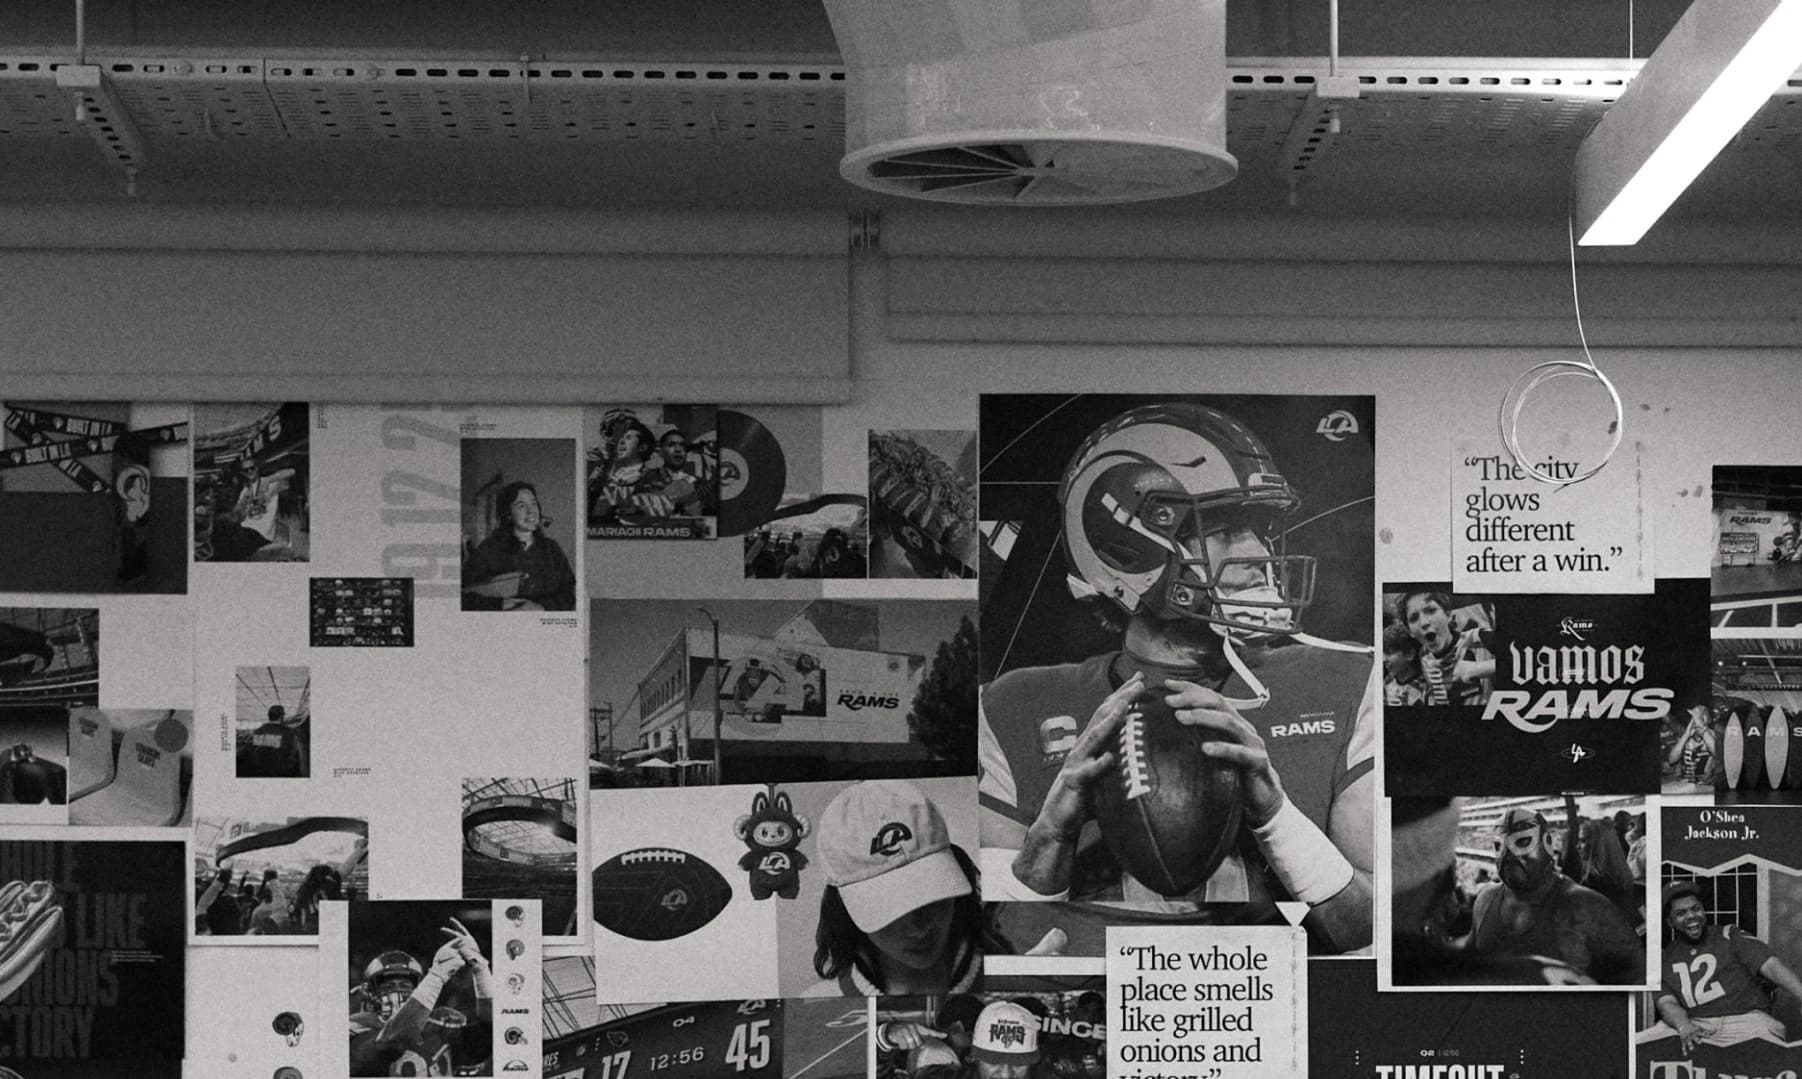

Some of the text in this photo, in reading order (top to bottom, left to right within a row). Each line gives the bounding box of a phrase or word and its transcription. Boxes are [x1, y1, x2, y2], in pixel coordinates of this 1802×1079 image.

[1464, 455, 1579, 493] “The city
[1466, 486, 1540, 519] glows
[643, 527, 691, 537] RAMS
[1466, 516, 1575, 542] different
[1466, 547, 1623, 572] after a win.”
[1560, 616, 1594, 641] Rams
[837, 694, 900, 711] RAMS
[1481, 687, 1675, 733] RAMS
[1270, 719, 1336, 738] RAMS
[1684, 826, 1760, 841] Jackson Jr.
[1119, 945, 1268, 970] “The whole
[1119, 976, 1273, 1009] place smells
[1671, 952, 1726, 1008] 12
[1035, 1014, 1107, 1042] SINCE
[1119, 1007, 1253, 1039] like grilled
[725, 1018, 771, 1072] 45
[1119, 1038, 1262, 1062] onions and
[650, 1046, 705, 1071] 12:56
